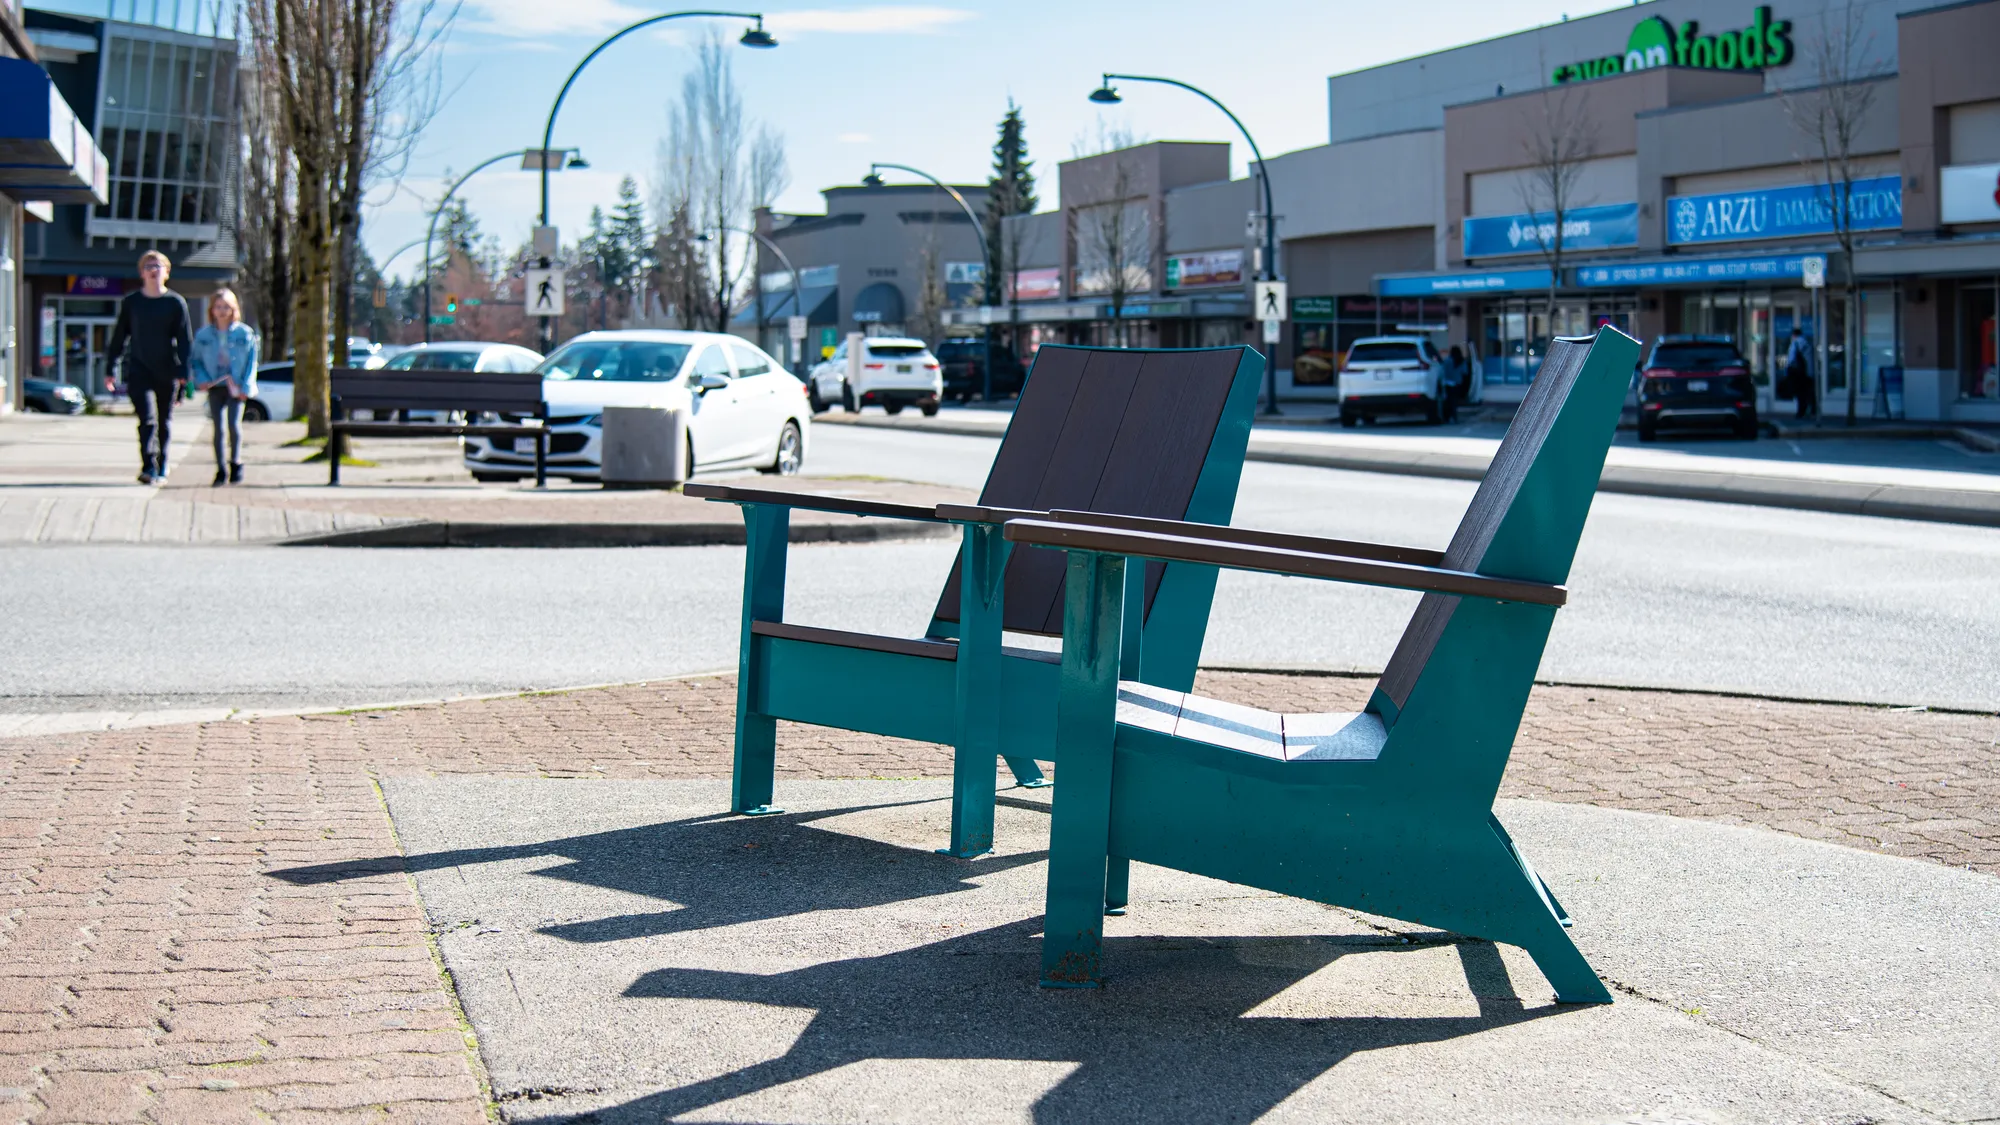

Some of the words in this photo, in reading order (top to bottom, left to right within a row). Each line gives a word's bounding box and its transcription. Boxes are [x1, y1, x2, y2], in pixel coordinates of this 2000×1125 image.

[1624, 44, 1669, 73] on
[1675, 6, 1791, 70] foods
[1701, 196, 1768, 237] ARZU
